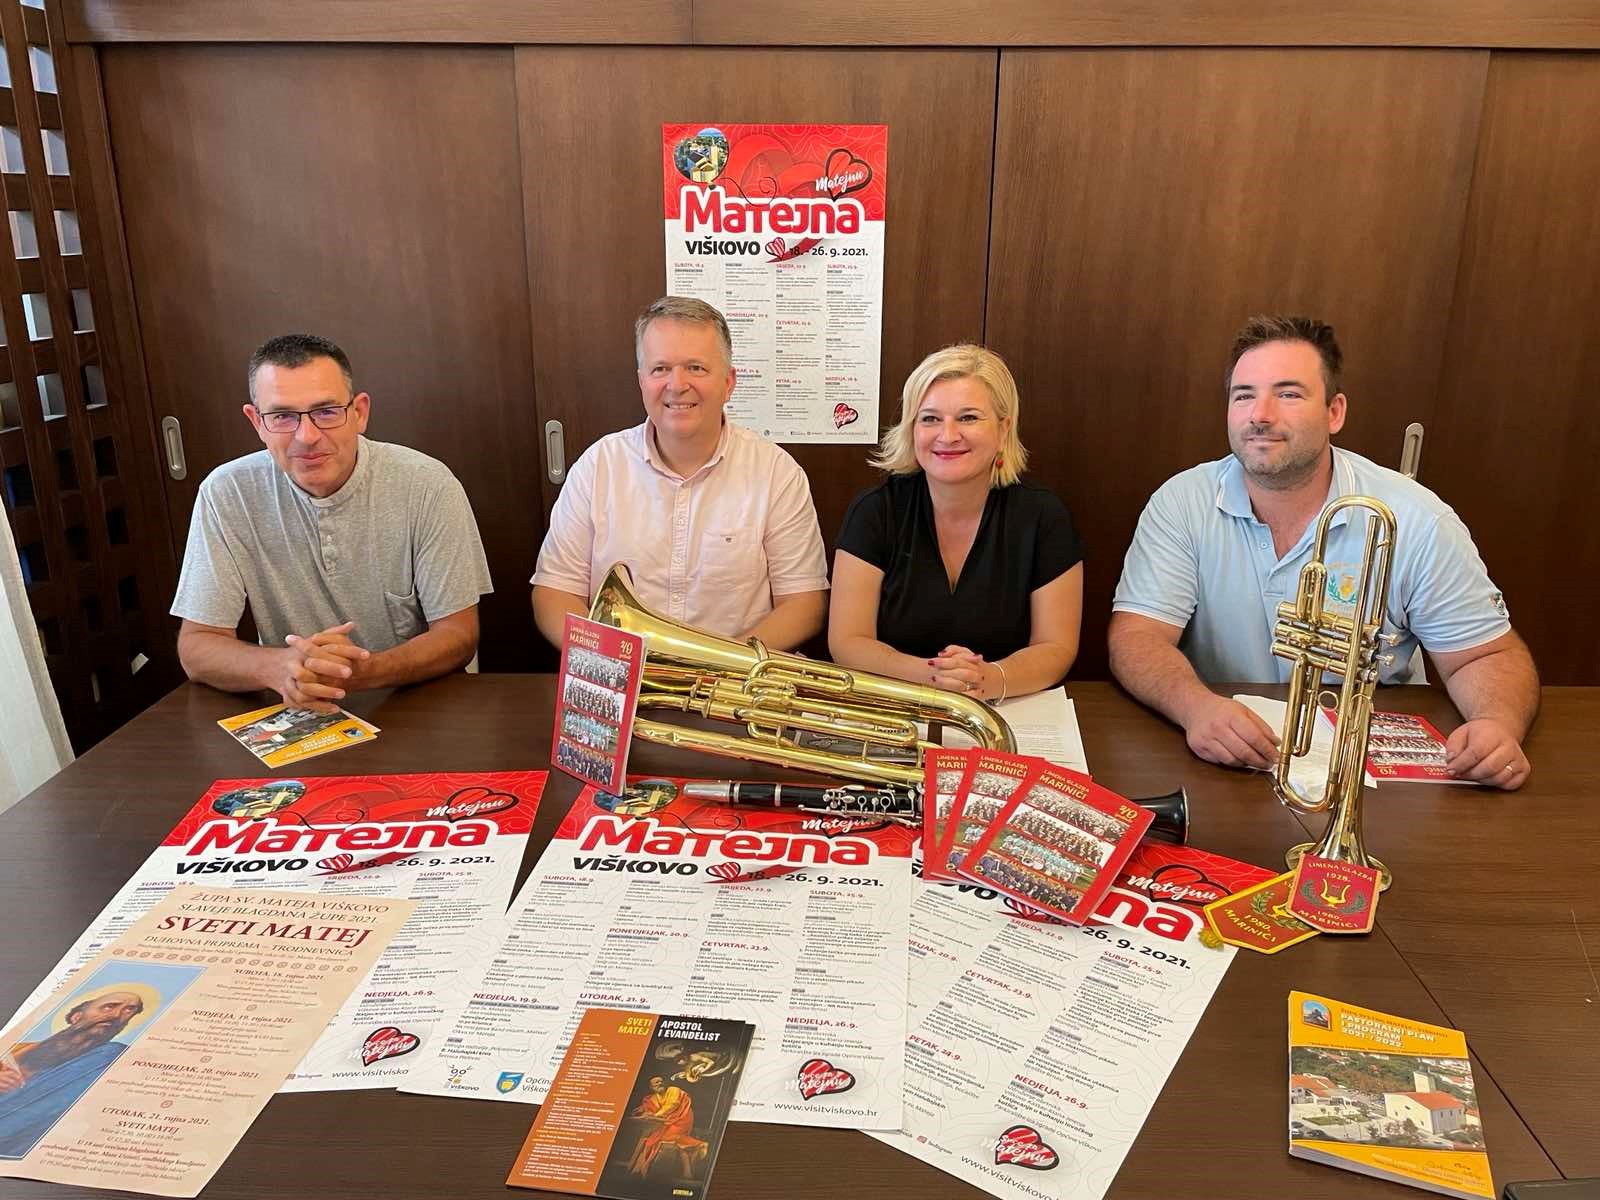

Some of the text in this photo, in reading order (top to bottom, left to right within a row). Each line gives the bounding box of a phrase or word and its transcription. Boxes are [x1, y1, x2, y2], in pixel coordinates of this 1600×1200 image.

[816, 171, 864, 192] Matejnu
[685, 190, 860, 234] Matejna
[685, 236, 761, 256] VIŠKOVO
[811, 246, 828, 257] 26.
[829, 247, 840, 259] 9.
[842, 246, 869, 257] 2021.
[426, 797, 507, 818] Matejnu
[186, 820, 490, 856] Matejna
[580, 817, 872, 865] Matejna
[175, 856, 309, 875] VIŠKOVO
[396, 858, 425, 868] 26.
[429, 858, 449, 869] 9.
[451, 856, 496, 866] 2021.
[573, 855, 698, 875] VIŠKOVO
[1308, 862, 1374, 882] LIMENA GLAZBA
[784, 872, 813, 883] 26.
[817, 874, 837, 886] 9.
[839, 876, 884, 887] 2021.
[1326, 872, 1352, 883] 1928.
[1127, 873, 1218, 902] Matejnu
[190, 892, 390, 914] ŽUPA SV. MATEJA VIŠKOVO
[232, 905, 306, 920] BLAGDANA
[1244, 912, 1272, 932] 1980.
[157, 916, 259, 937] SVETI
[258, 921, 374, 948] MATEJ
[1082, 927, 1191, 970] 26. 9. 2021.
[965, 969, 1011, 992] ČETVRTAK,
[579, 992, 624, 1002] UTORAK,
[618, 1025, 649, 1036] MATEJ
[626, 1017, 653, 1027] SVETI
[660, 1020, 703, 1032] APOSTOL
[786, 1017, 834, 1027] NEDJELJA,
[1341, 1013, 1436, 1042] PASTORALNI PLAN
[1346, 1022, 1402, 1041] PROGRAM
[658, 1029, 663, 1037] I
[909, 1034, 940, 1053] PETAK,
[331, 1066, 409, 1080] www.visitvisko
[525, 1076, 552, 1086] Općin
[522, 1084, 549, 1093] Viškov
[1014, 1074, 1063, 1099] NEDJELJA,
[774, 1102, 878, 1117] www.visitviskovo.hr
[961, 1155, 1058, 1200] www.visitviskovo
